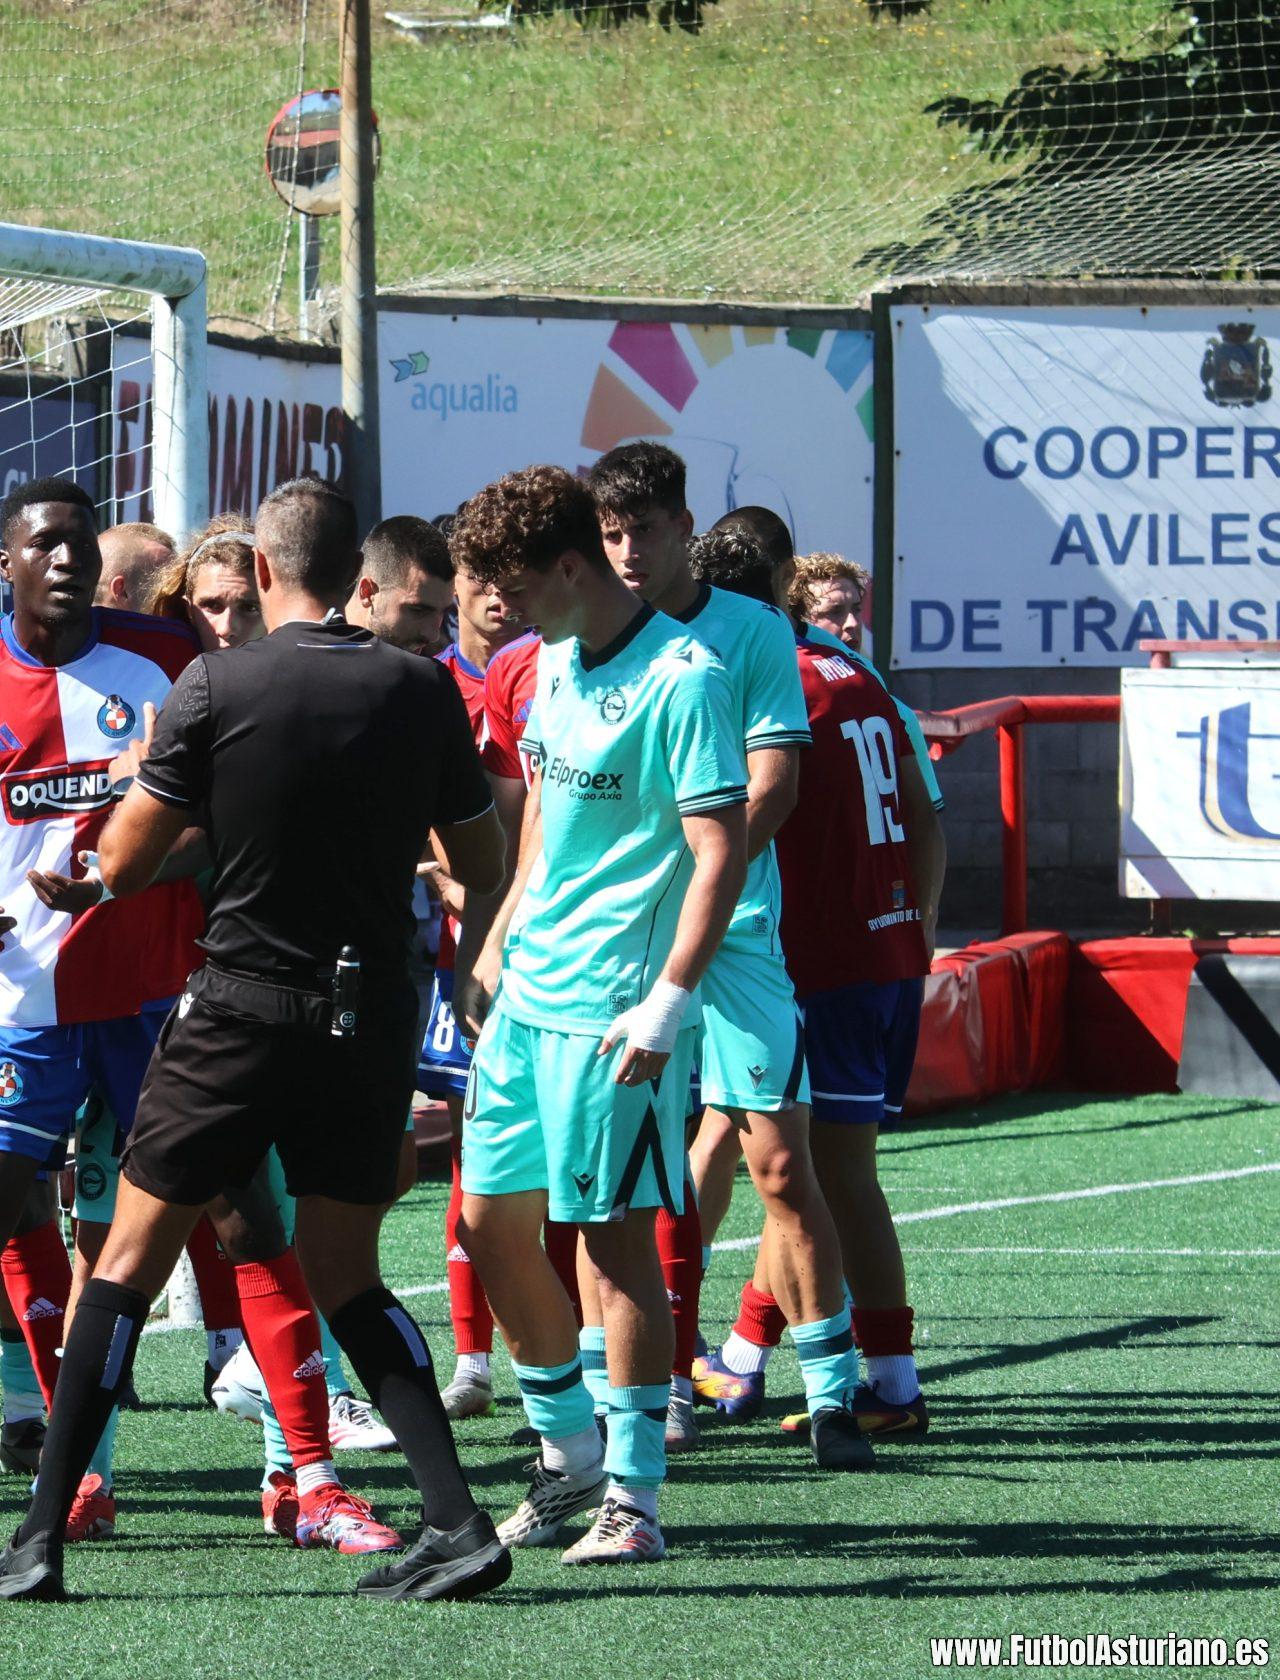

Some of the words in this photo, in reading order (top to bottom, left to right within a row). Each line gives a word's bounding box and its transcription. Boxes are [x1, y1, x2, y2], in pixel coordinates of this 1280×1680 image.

[411, 373, 519, 420] aqualia
[983, 425, 1280, 480] COOPER
[910, 599, 1002, 653] DE
[1027, 598, 1280, 653] TRANS
[10, 773, 113, 810] OQUEND
[548, 756, 624, 790] Elproex
[568, 787, 597, 802] Grupo
[598, 789, 623, 801] Axia
[840, 716, 905, 846] 19
[905, 908, 914, 922] DE
[432, 1001, 456, 1053] 8
